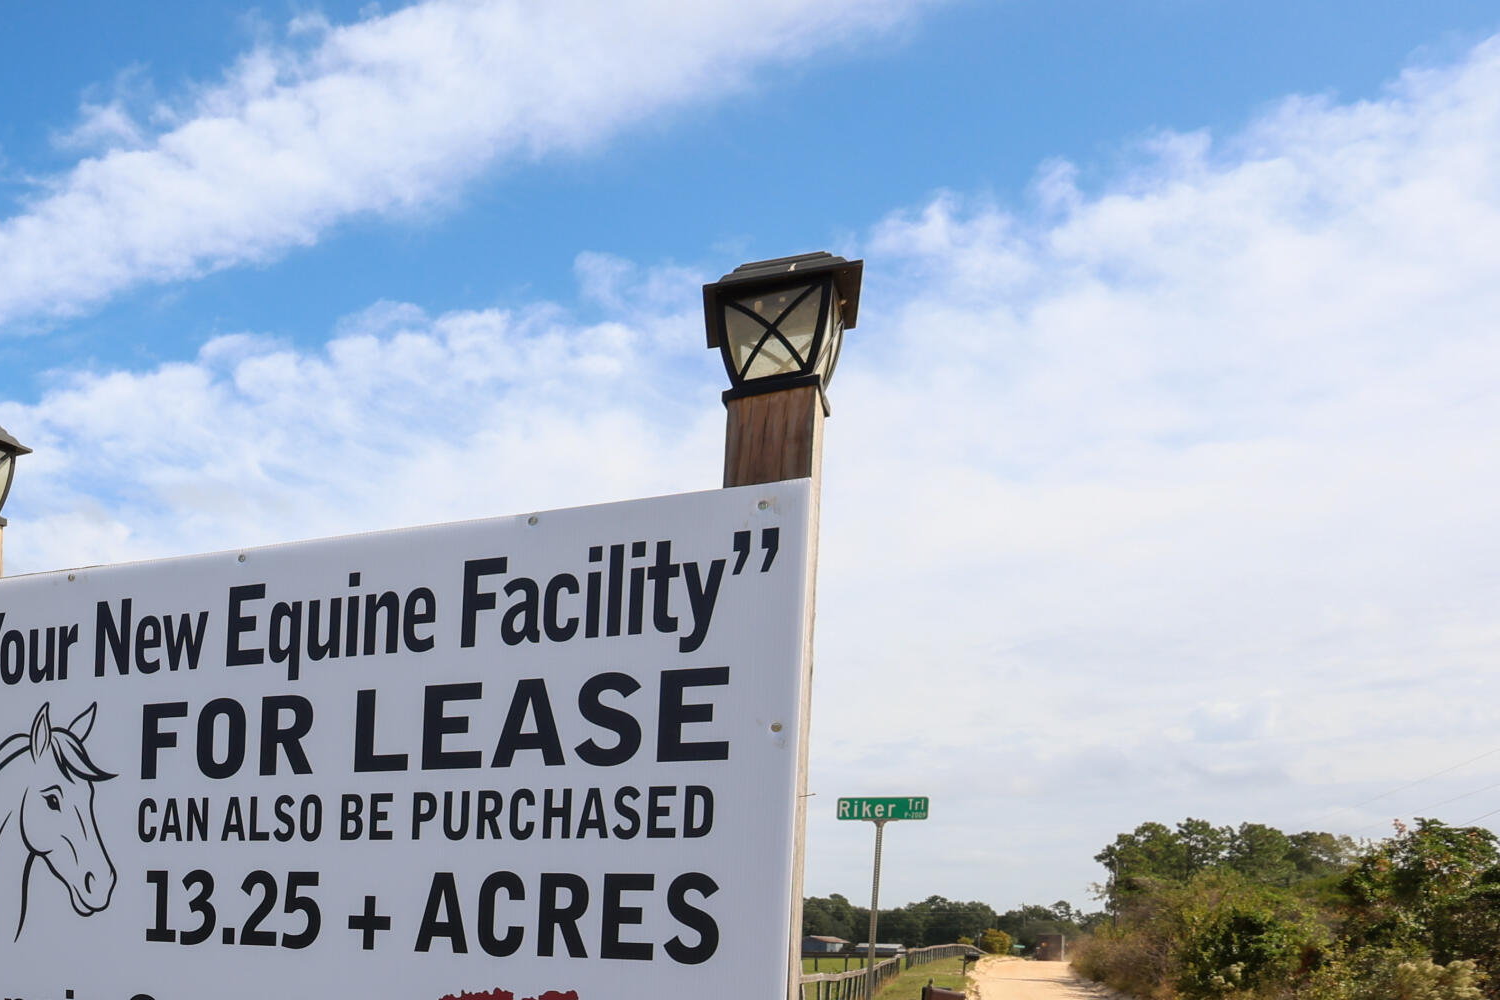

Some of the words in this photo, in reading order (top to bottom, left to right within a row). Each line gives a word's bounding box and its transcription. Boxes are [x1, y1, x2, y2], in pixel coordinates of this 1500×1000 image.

[94, 597, 210, 678] New
[225, 571, 437, 681] Equine
[140, 694, 314, 780] FOR
[353, 665, 730, 773] LEASE
[137, 797, 209, 843] CAN
[220, 793, 323, 843] ALSO
[339, 792, 394, 841] BE
[411, 785, 714, 841] PURCHASED
[839, 800, 896, 818] Riker
[145, 869, 322, 950] 13.25
[347, 895, 392, 951] +
[413, 871, 720, 966] ACRES
